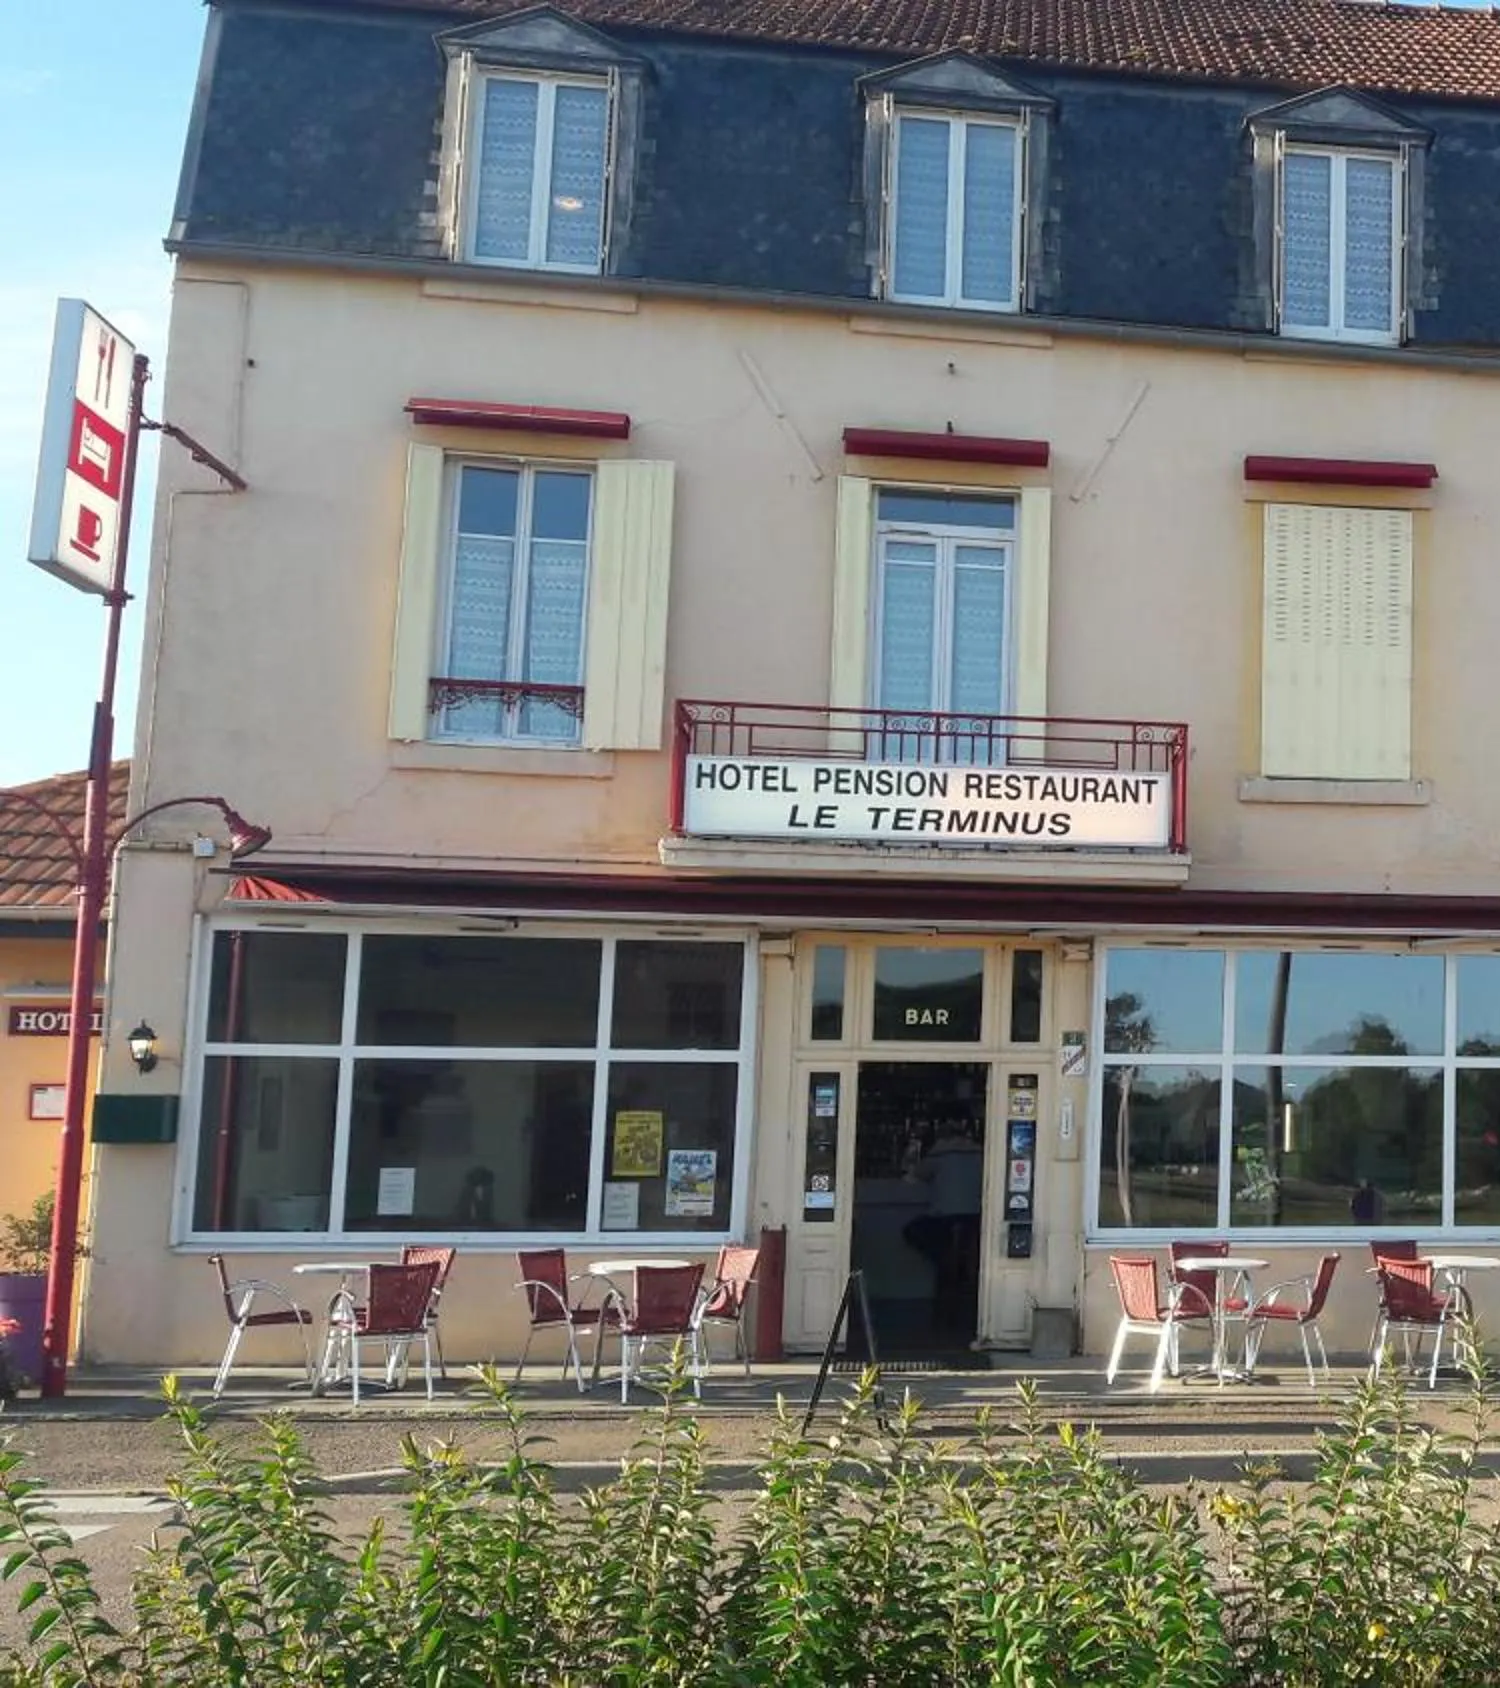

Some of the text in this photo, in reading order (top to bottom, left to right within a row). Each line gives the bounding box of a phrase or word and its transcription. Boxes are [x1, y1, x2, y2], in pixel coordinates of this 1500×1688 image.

[695, 763, 1158, 804] HOTEL PENSION RESTAURANT
[788, 804, 1072, 835] LE TERMINUS
[17, 1011, 104, 1031] HOTL
[905, 1009, 949, 1025] BAR
